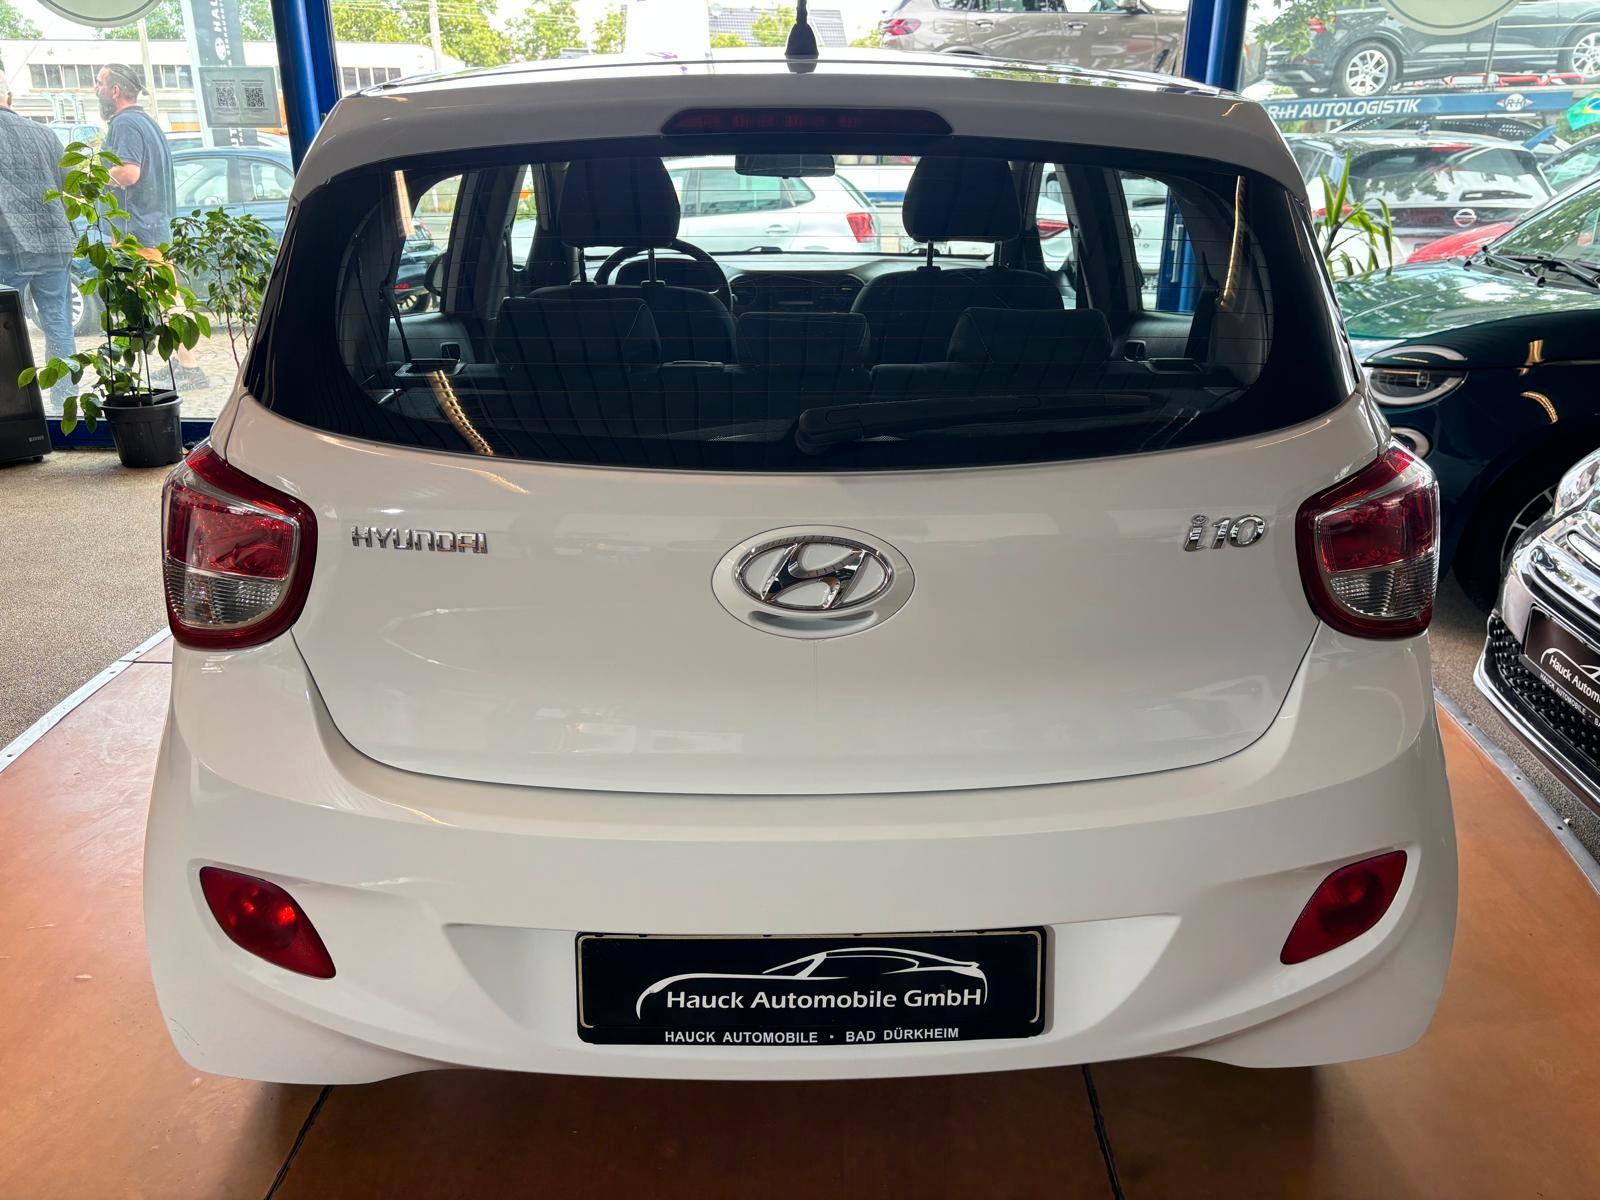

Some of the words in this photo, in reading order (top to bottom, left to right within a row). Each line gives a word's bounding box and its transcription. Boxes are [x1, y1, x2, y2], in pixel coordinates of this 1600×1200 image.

[1267, 103, 1299, 119] R+H
[1300, 98, 1422, 118] AUTOLOGISTIK
[351, 525, 488, 555] HYUNDAI
[1183, 513, 1266, 552] i10
[1549, 655, 1573, 681] Hauck
[1571, 675, 1600, 704] Autom
[1555, 687, 1587, 716] AUTOMOBILE
[666, 991, 744, 1009] Hauck
[750, 990, 897, 1009] Automobile
[903, 988, 981, 1007] GmbH
[664, 1031, 716, 1043] HAUCK
[722, 1031, 818, 1043] AUTOMOBILE
[845, 1030, 876, 1042] BAD
[883, 1027, 959, 1041] DÜRKHEIM
